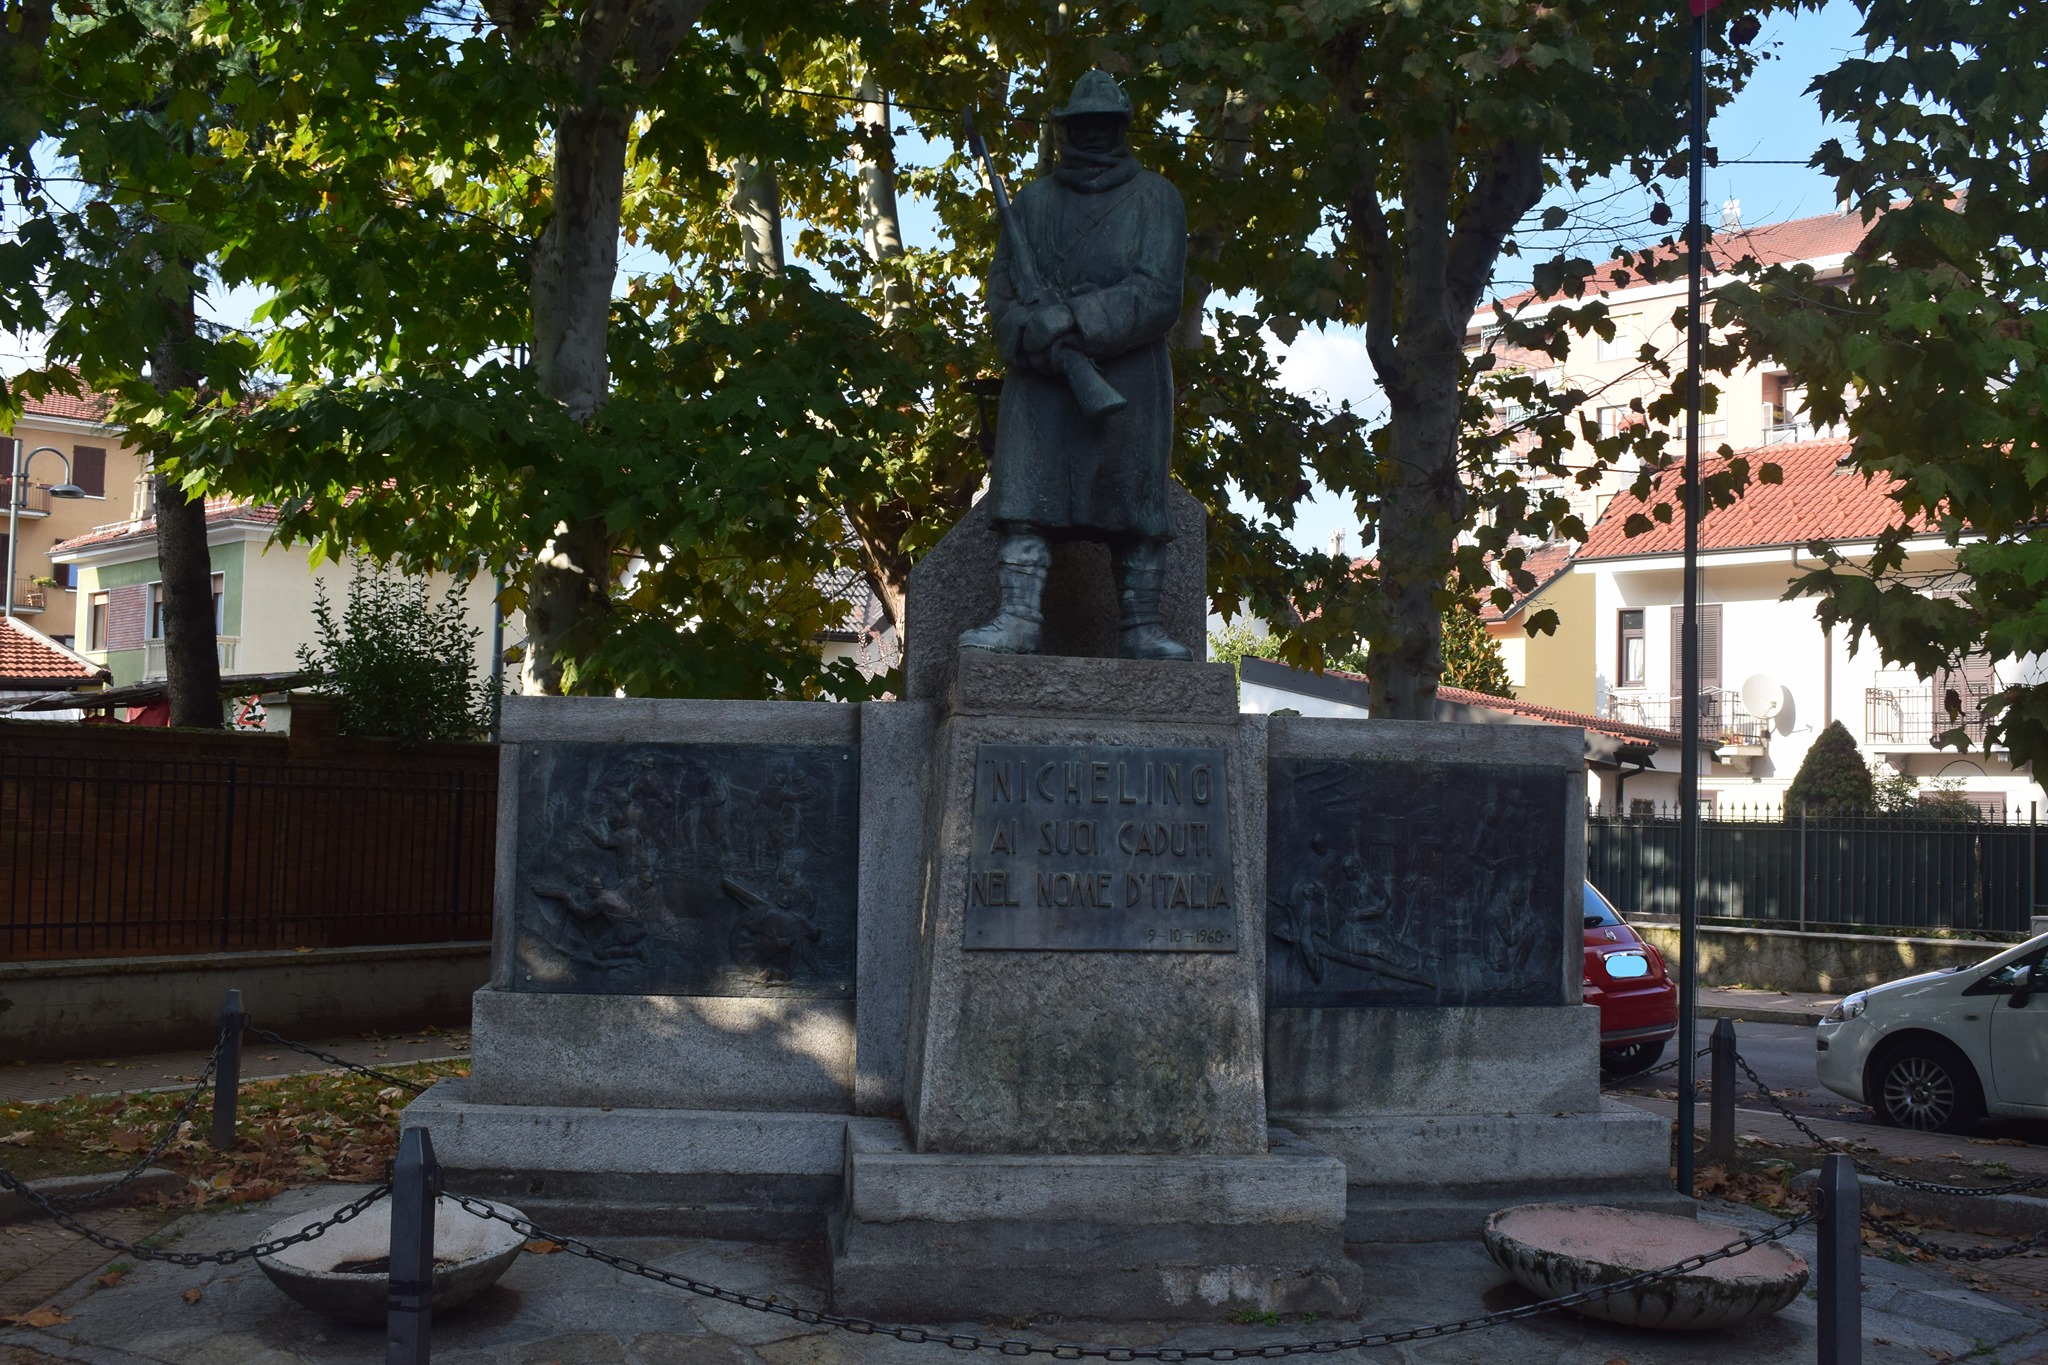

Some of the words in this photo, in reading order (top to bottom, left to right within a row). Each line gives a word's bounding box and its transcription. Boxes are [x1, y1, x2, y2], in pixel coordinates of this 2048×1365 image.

[992, 760, 1211, 804] NICHELINO
[991, 818, 1017, 855] AI
[1038, 819, 1099, 855] SUOI
[1118, 821, 1212, 857] CADUTI
[971, 870, 1020, 906] NEL
[1037, 872, 1112, 908] NOME
[1126, 873, 1231, 909] D'ITALIA
